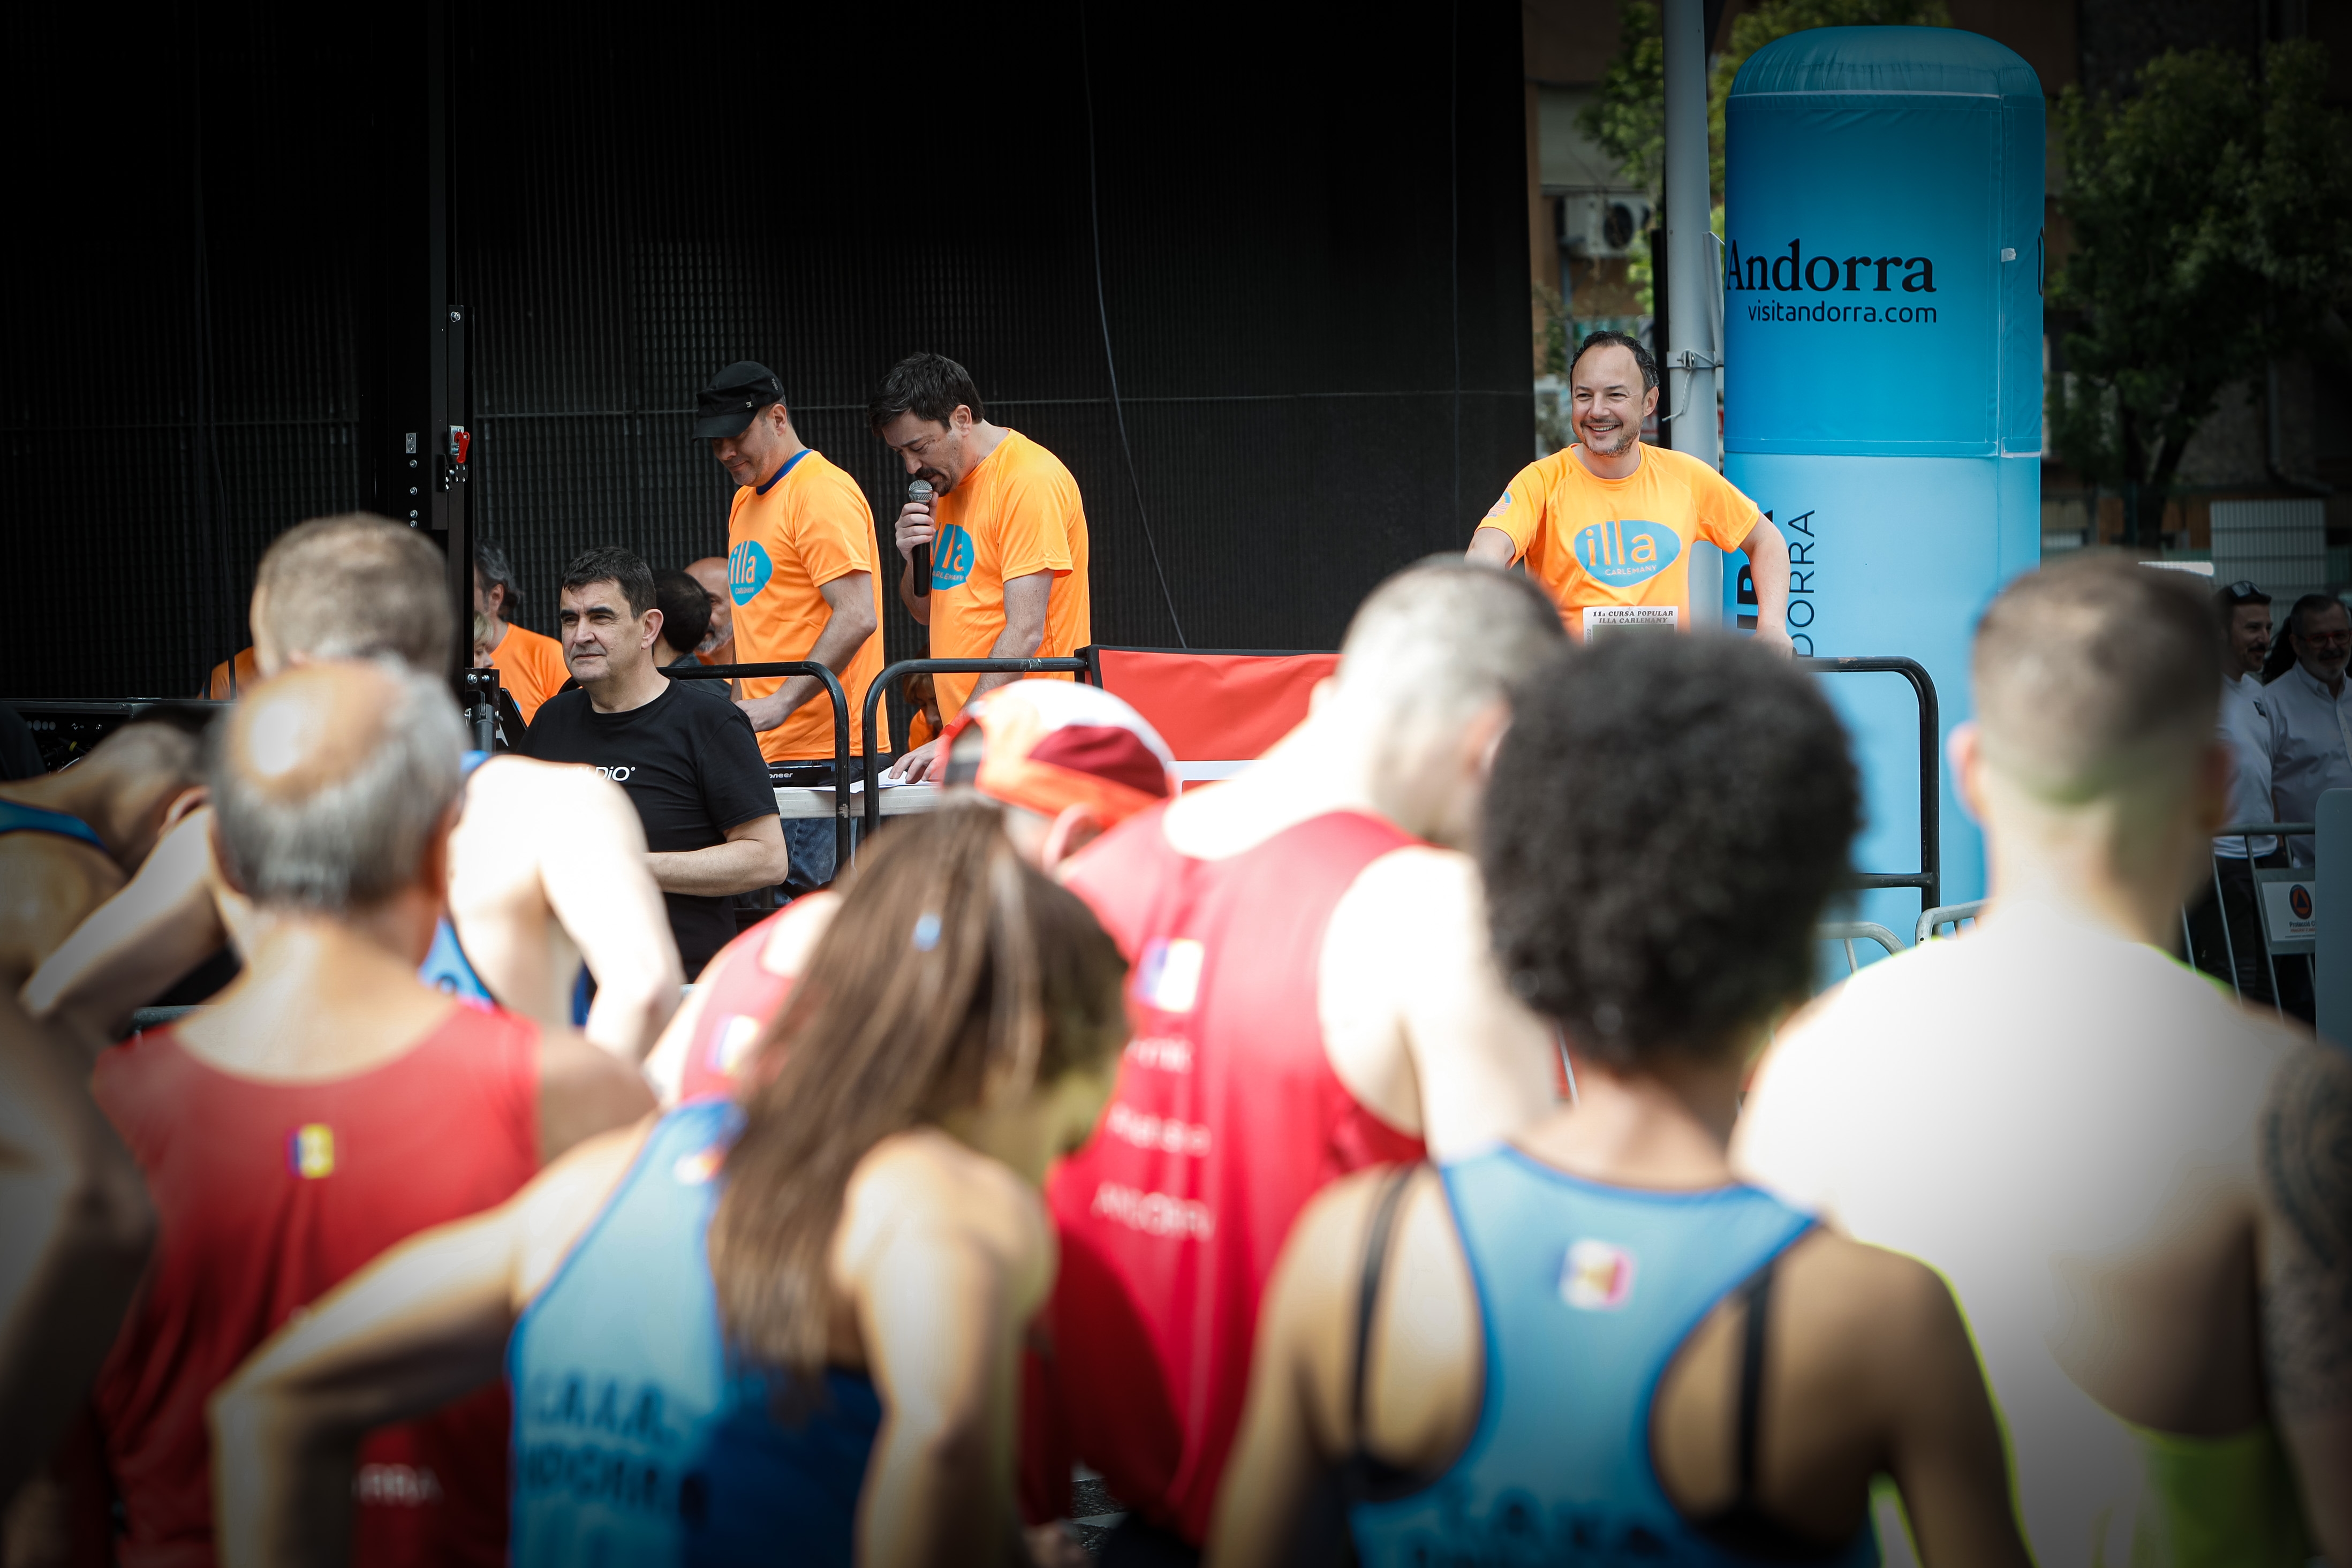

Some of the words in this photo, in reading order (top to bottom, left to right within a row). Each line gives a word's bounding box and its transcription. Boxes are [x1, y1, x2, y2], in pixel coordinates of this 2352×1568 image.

[1726, 238, 1937, 292] Andorra
[1748, 299, 1937, 323] visitandorra.com
[730, 541, 756, 584] illa
[1585, 520, 1657, 566] illa
[1605, 565, 1657, 576] CARLEMANY
